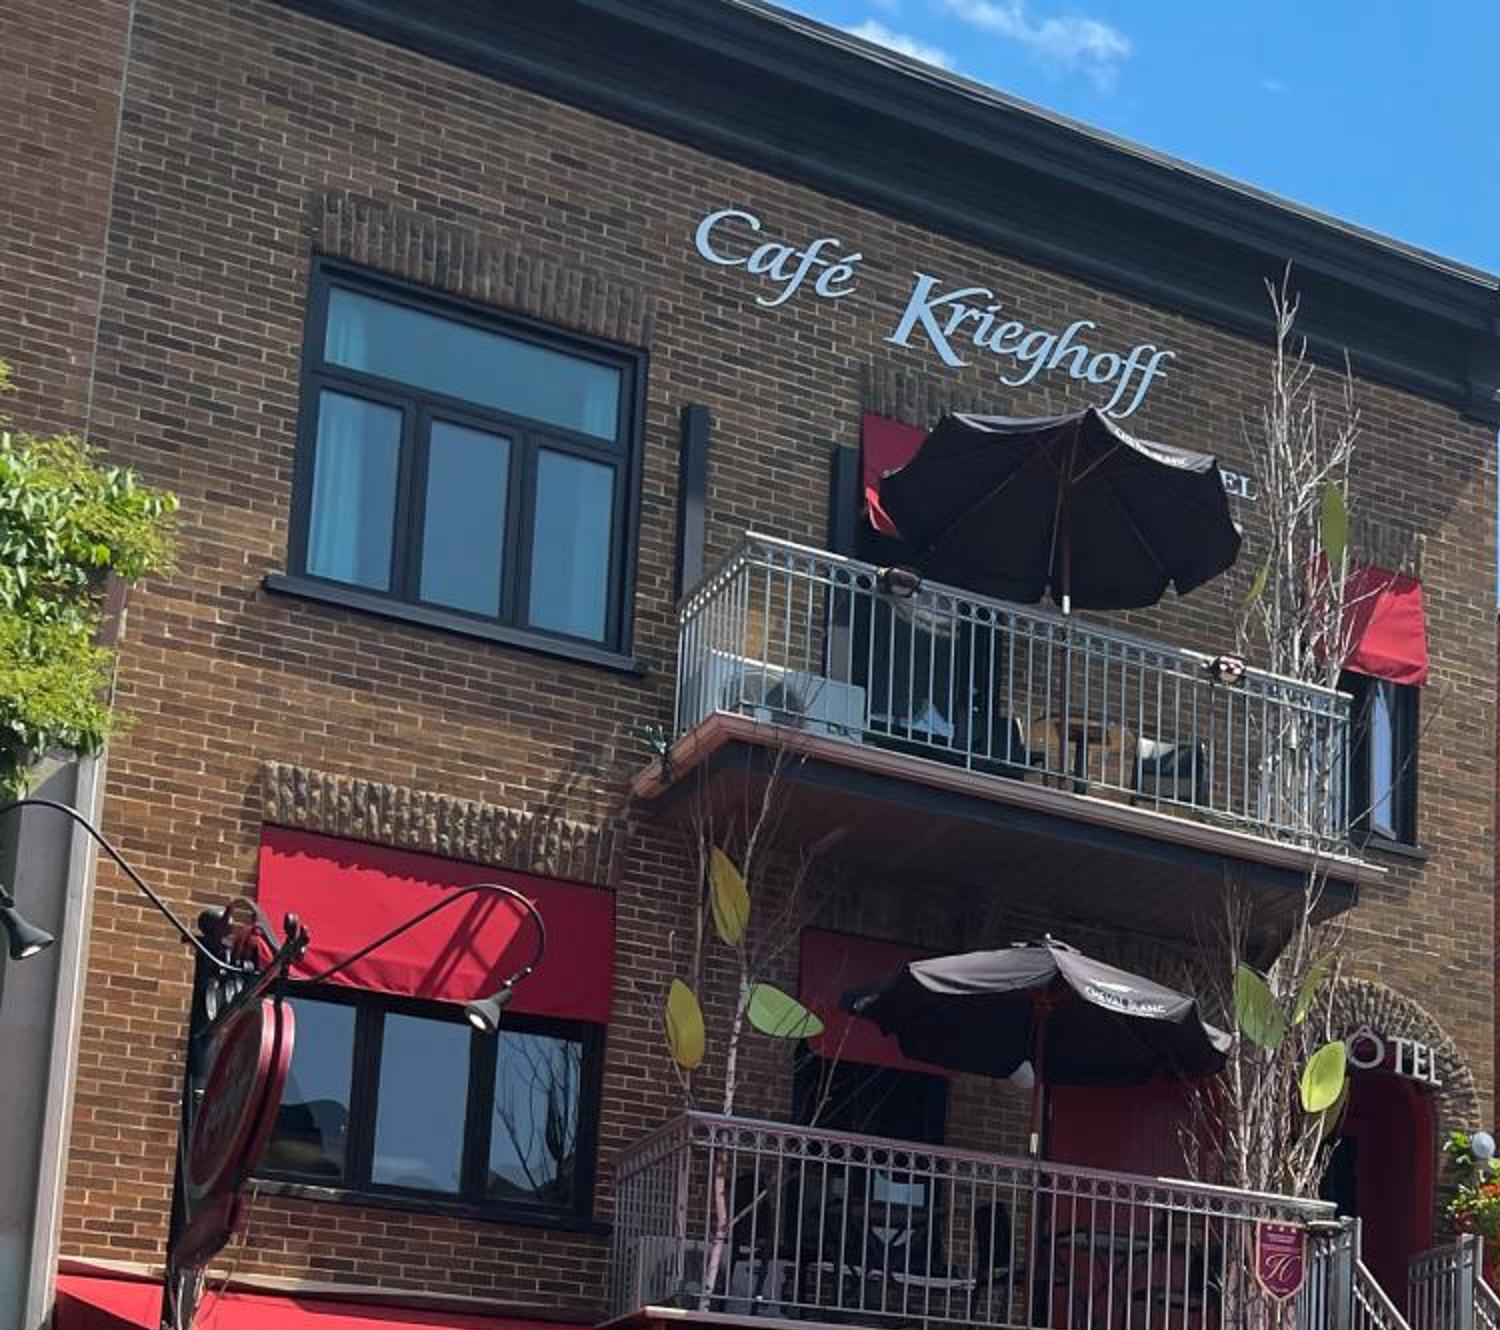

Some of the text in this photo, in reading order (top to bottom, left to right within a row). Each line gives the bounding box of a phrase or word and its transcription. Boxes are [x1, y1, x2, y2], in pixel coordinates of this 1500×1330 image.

[696, 210, 1176, 418] Café Krieghoff
[1345, 1025, 1443, 1086] ÔTEL
